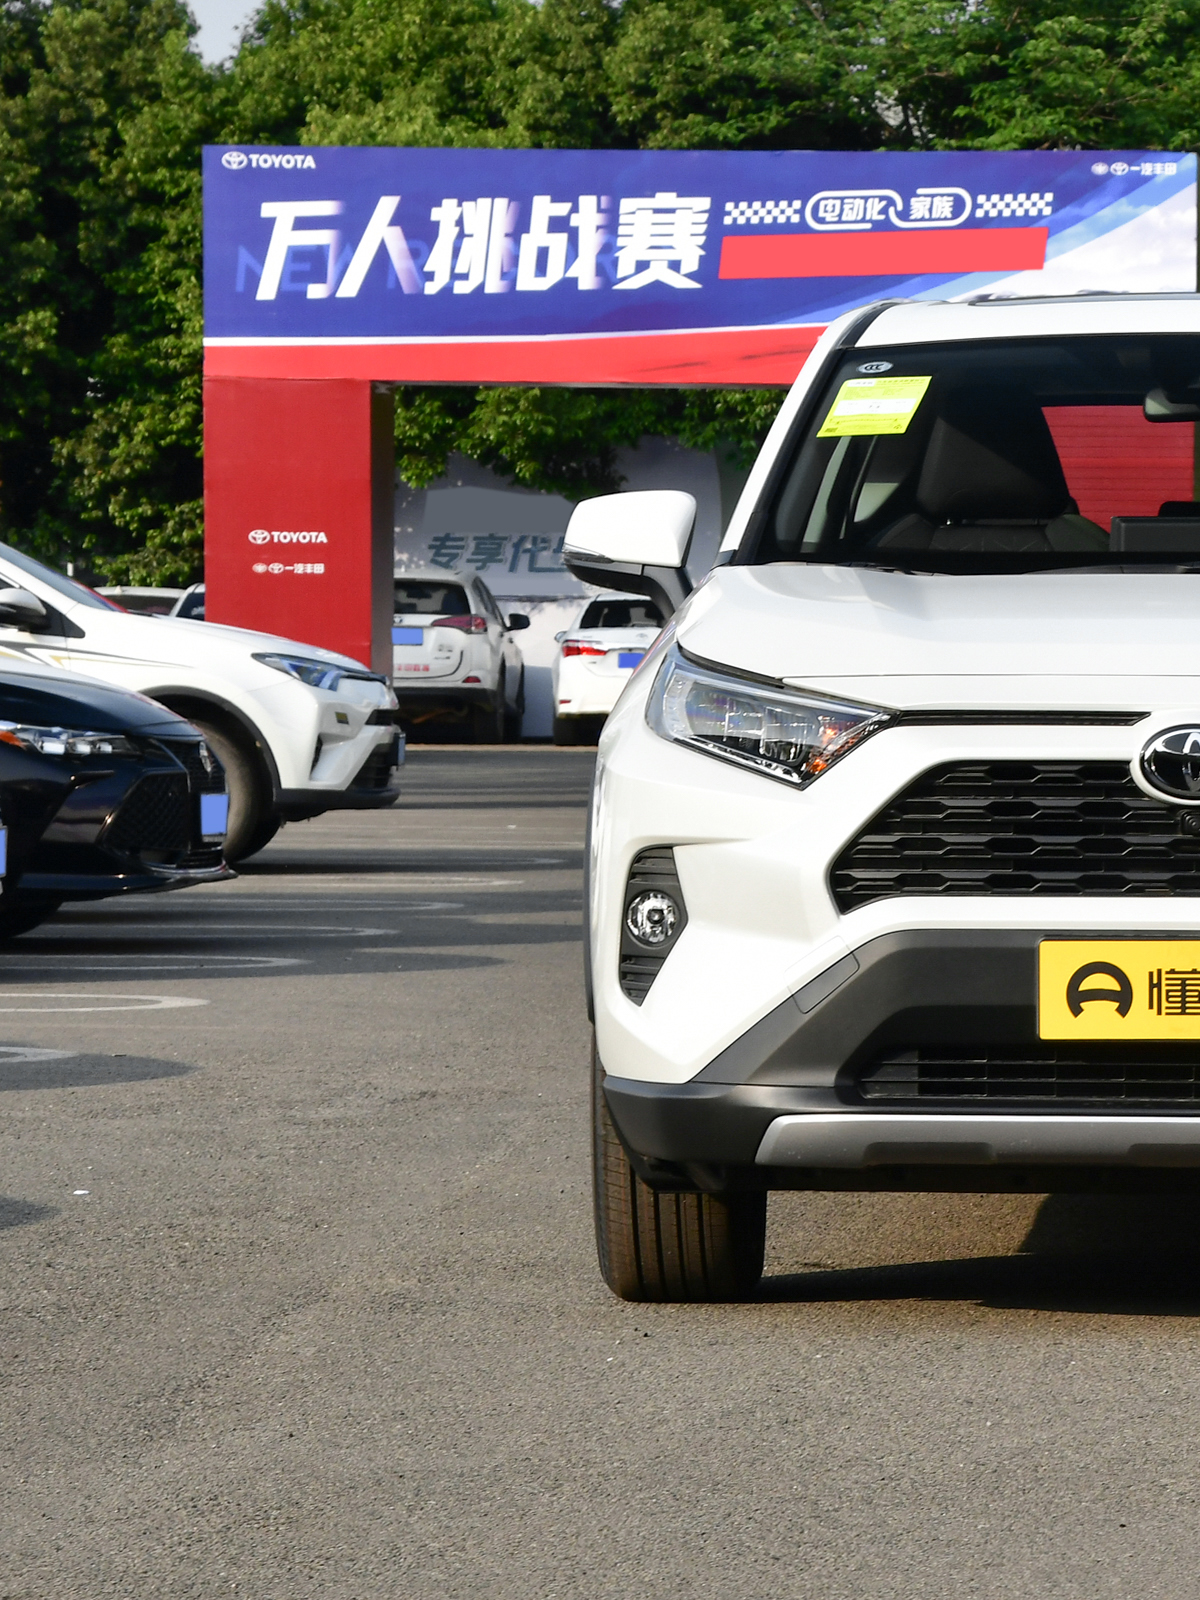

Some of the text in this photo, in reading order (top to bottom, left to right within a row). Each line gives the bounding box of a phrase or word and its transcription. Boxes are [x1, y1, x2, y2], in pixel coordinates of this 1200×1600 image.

[248, 153, 316, 169] TOYOTA
[818, 195, 954, 222] 电动化 家族
[255, 192, 711, 300] 万人挑战赛
[271, 531, 328, 544] TOYOTA
